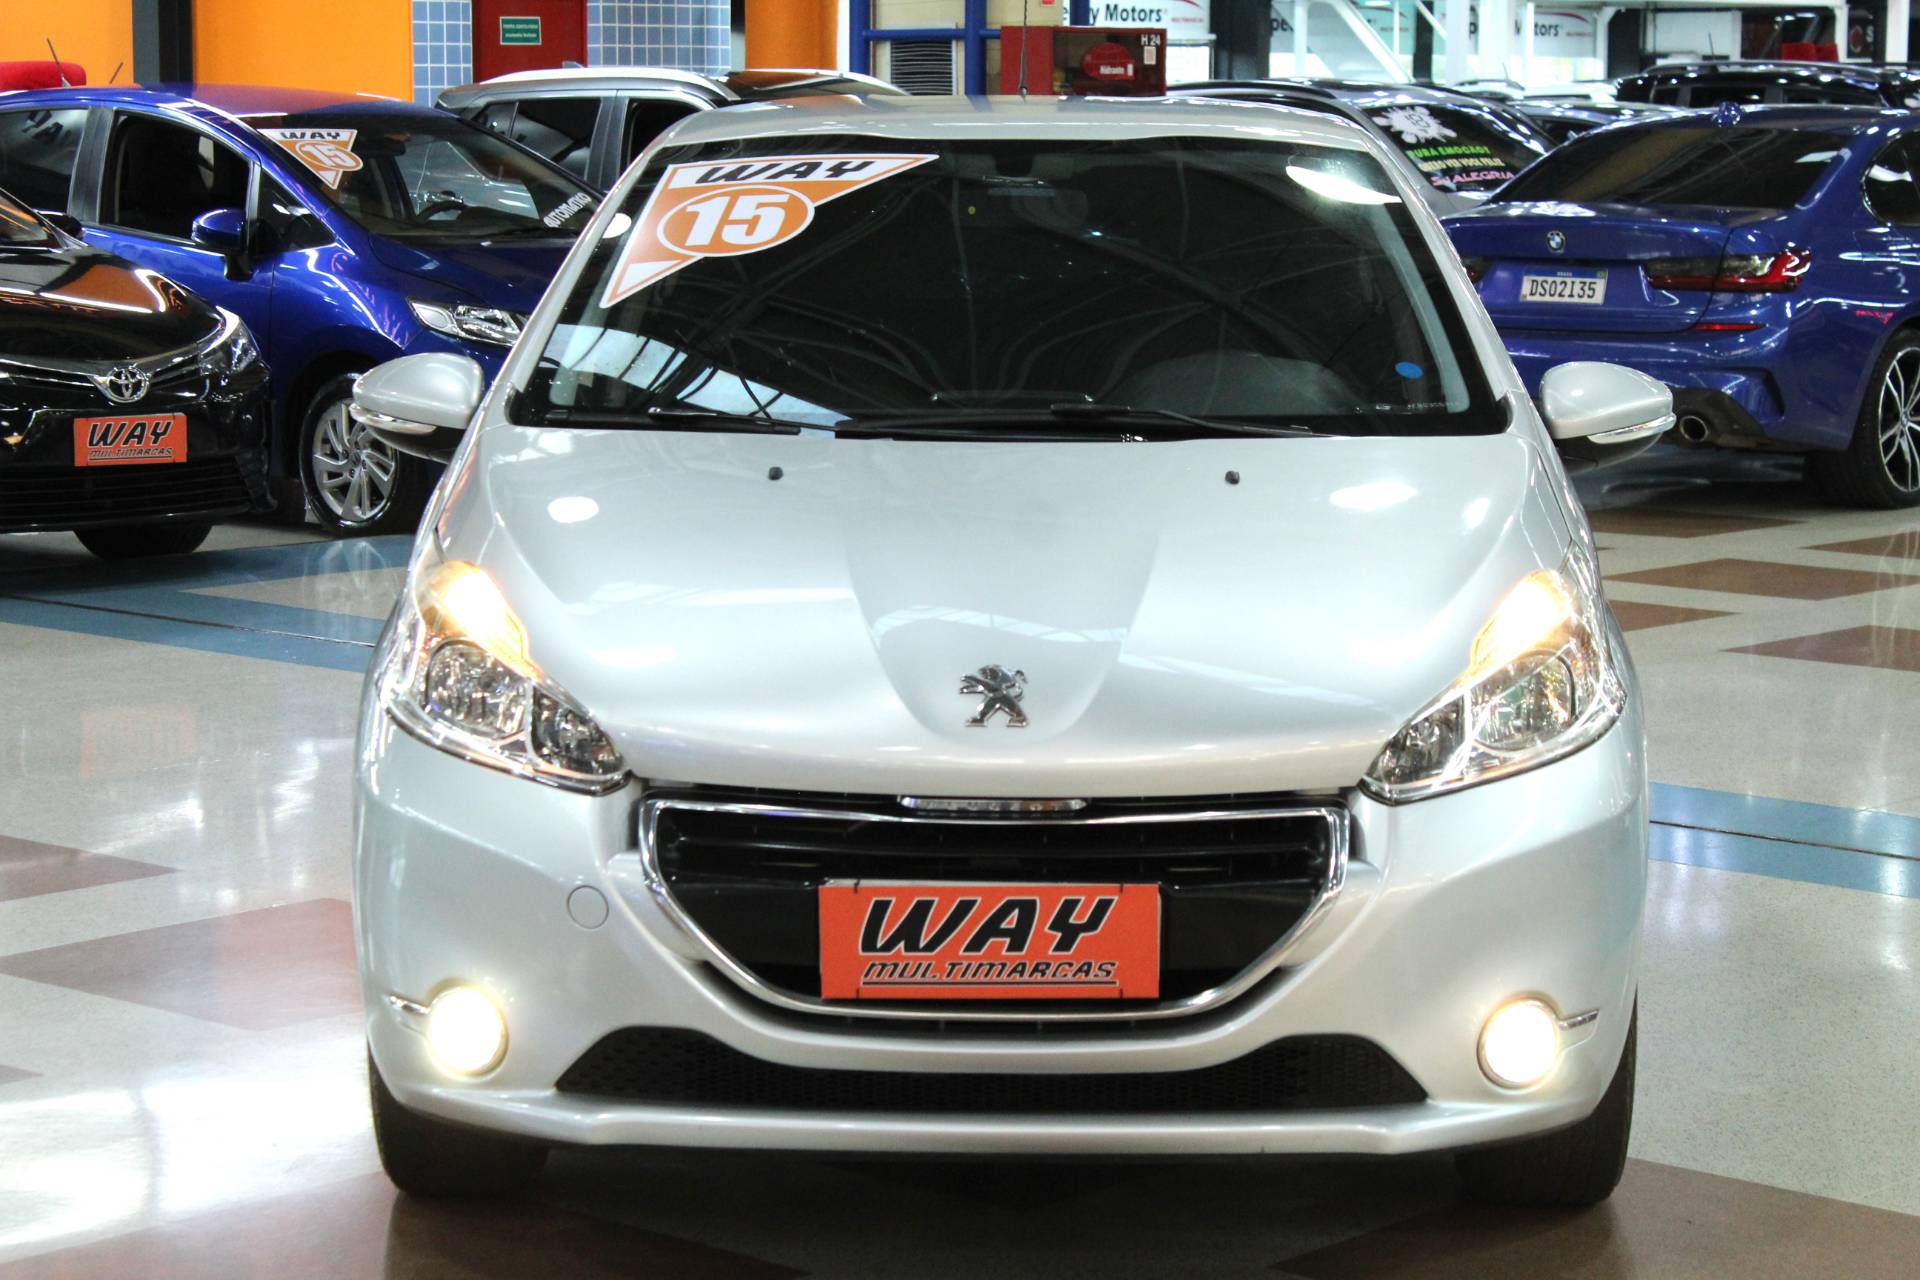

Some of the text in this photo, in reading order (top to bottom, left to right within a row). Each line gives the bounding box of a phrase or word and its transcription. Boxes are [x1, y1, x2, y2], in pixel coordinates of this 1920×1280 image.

[1104, 3, 1163, 23] Motors
[1141, 34, 1162, 46] H 24
[280, 131, 340, 140] WAY
[300, 144, 357, 168] 15
[695, 161, 876, 184] WAY
[684, 194, 790, 247] 15
[87, 421, 173, 448] WAY
[89, 448, 173, 459] MULTIMARCAS
[859, 896, 1119, 955] WAY
[862, 960, 1119, 980] MULTIMARCAS
